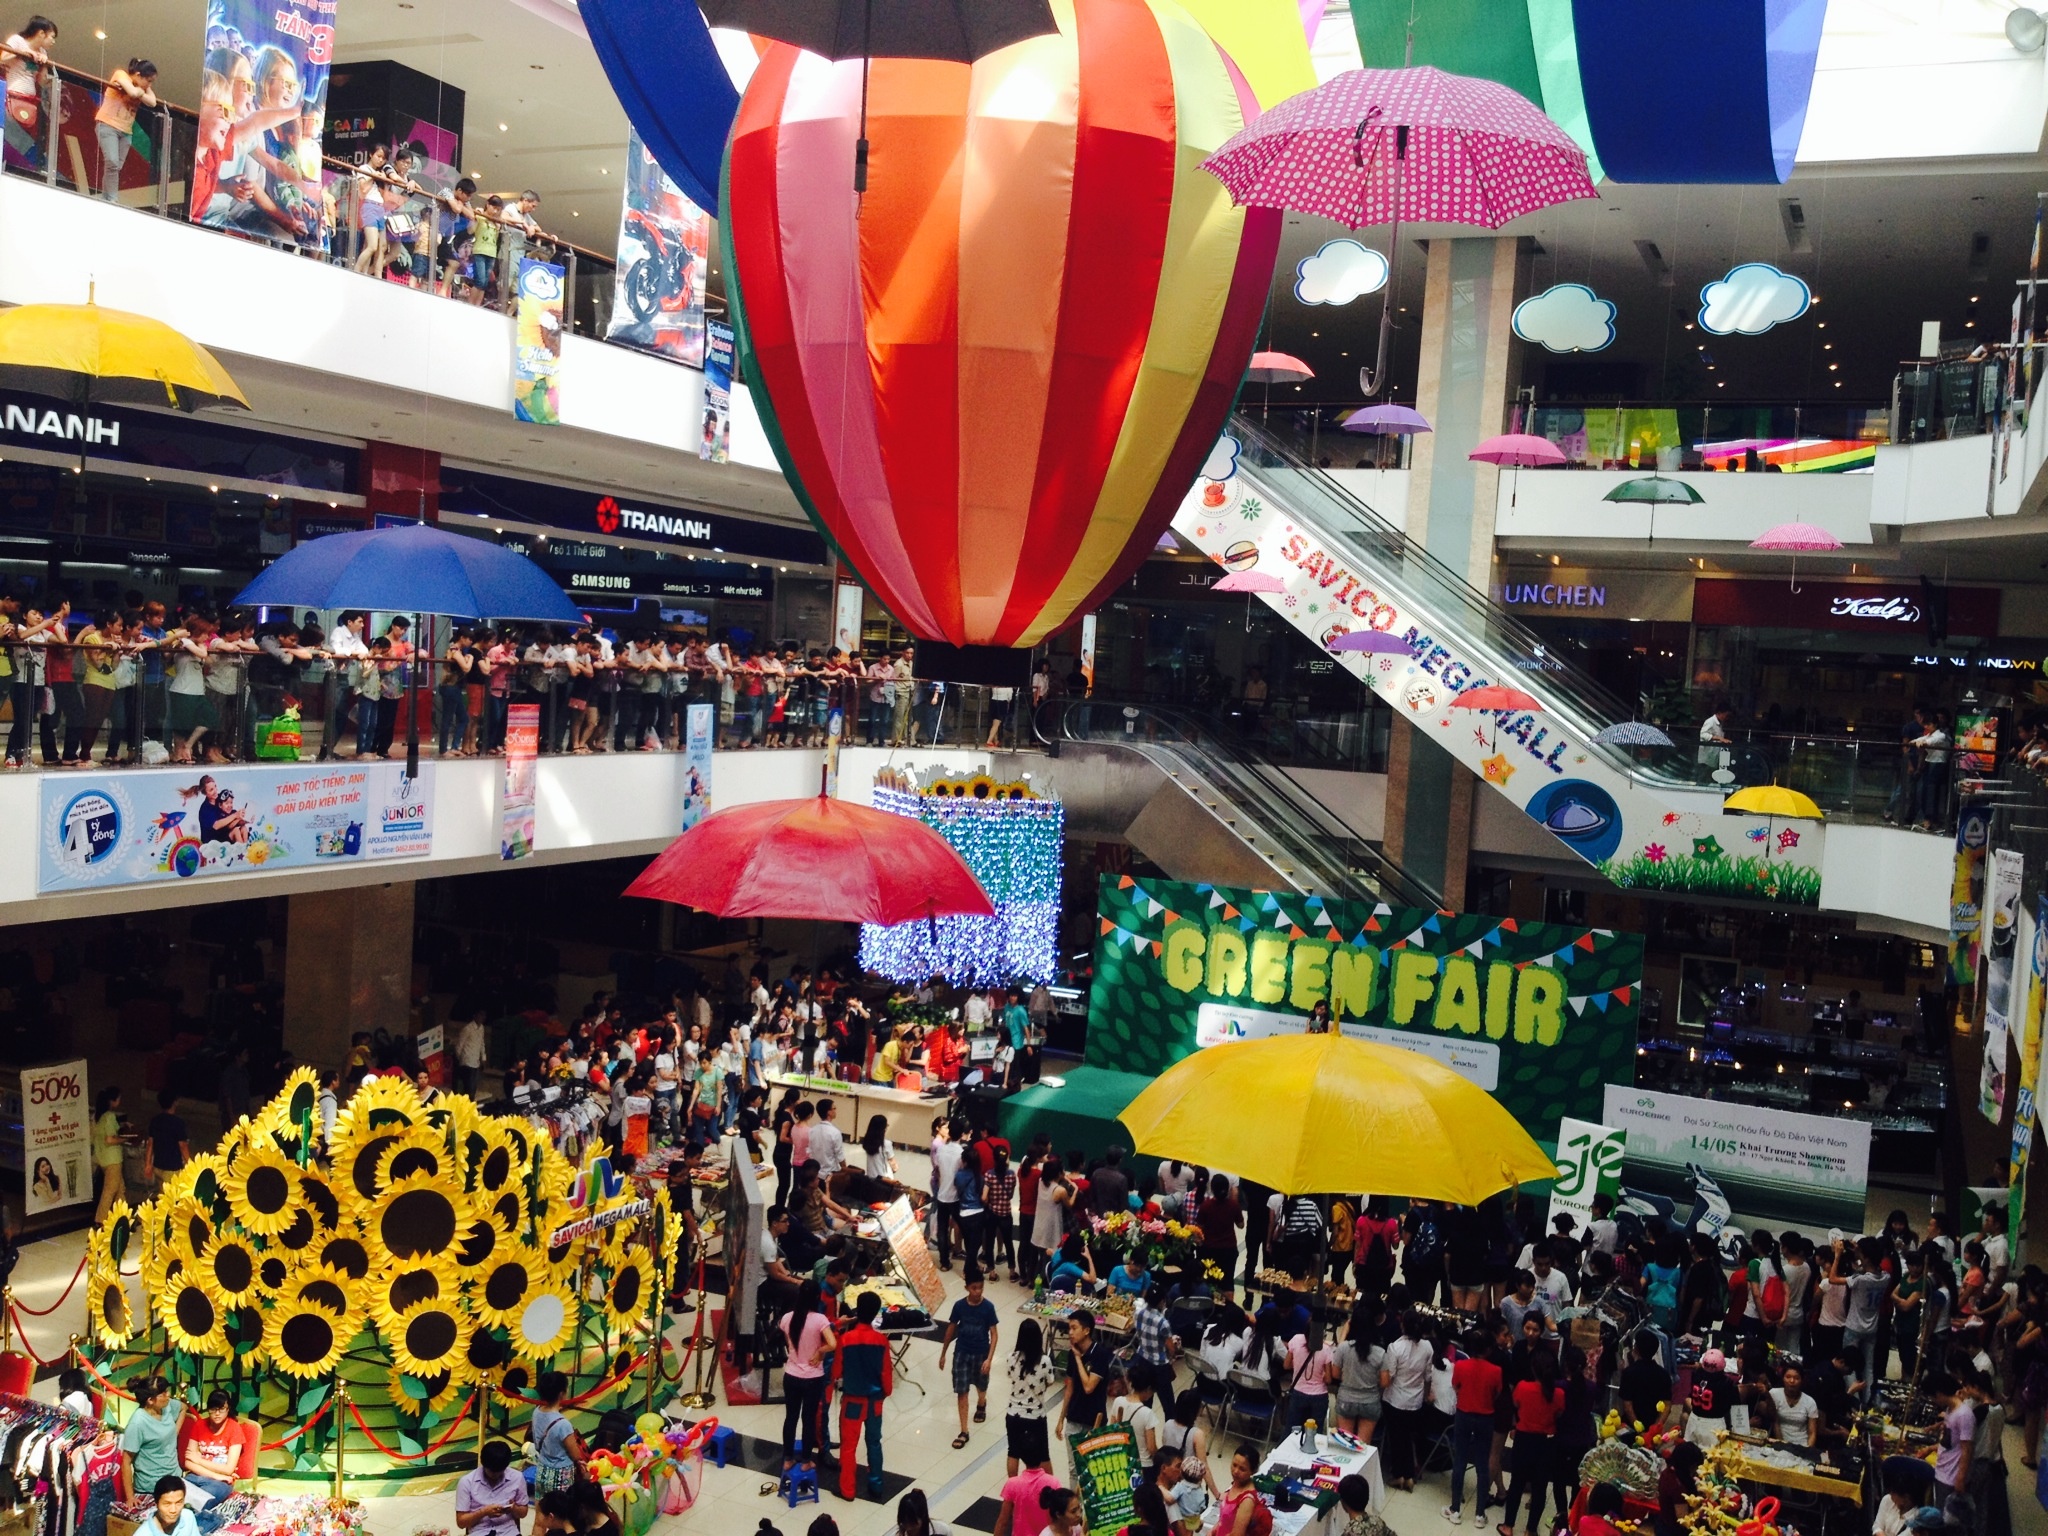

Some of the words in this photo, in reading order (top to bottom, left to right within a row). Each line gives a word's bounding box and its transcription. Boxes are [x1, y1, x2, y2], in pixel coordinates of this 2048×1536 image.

[0, 404, 120, 446] NANH
[620, 509, 710, 540] TRANANH
[128, 551, 170, 563] Panasonic
[571, 574, 631, 589] SAMSUNG
[663, 583, 690, 595] Samsung
[1281, 534, 1397, 632] SAVICO
[348, 773, 366, 784] ANH
[1161, 918, 1381, 1018] GREEN
[1388, 946, 1568, 1048] FAIR
[30, 1073, 81, 1105] 50%
[1690, 1134, 1738, 1156] 14/05
[1739, 1141, 1761, 1153] Khai
[1799, 1151, 1846, 1165] Showroom
